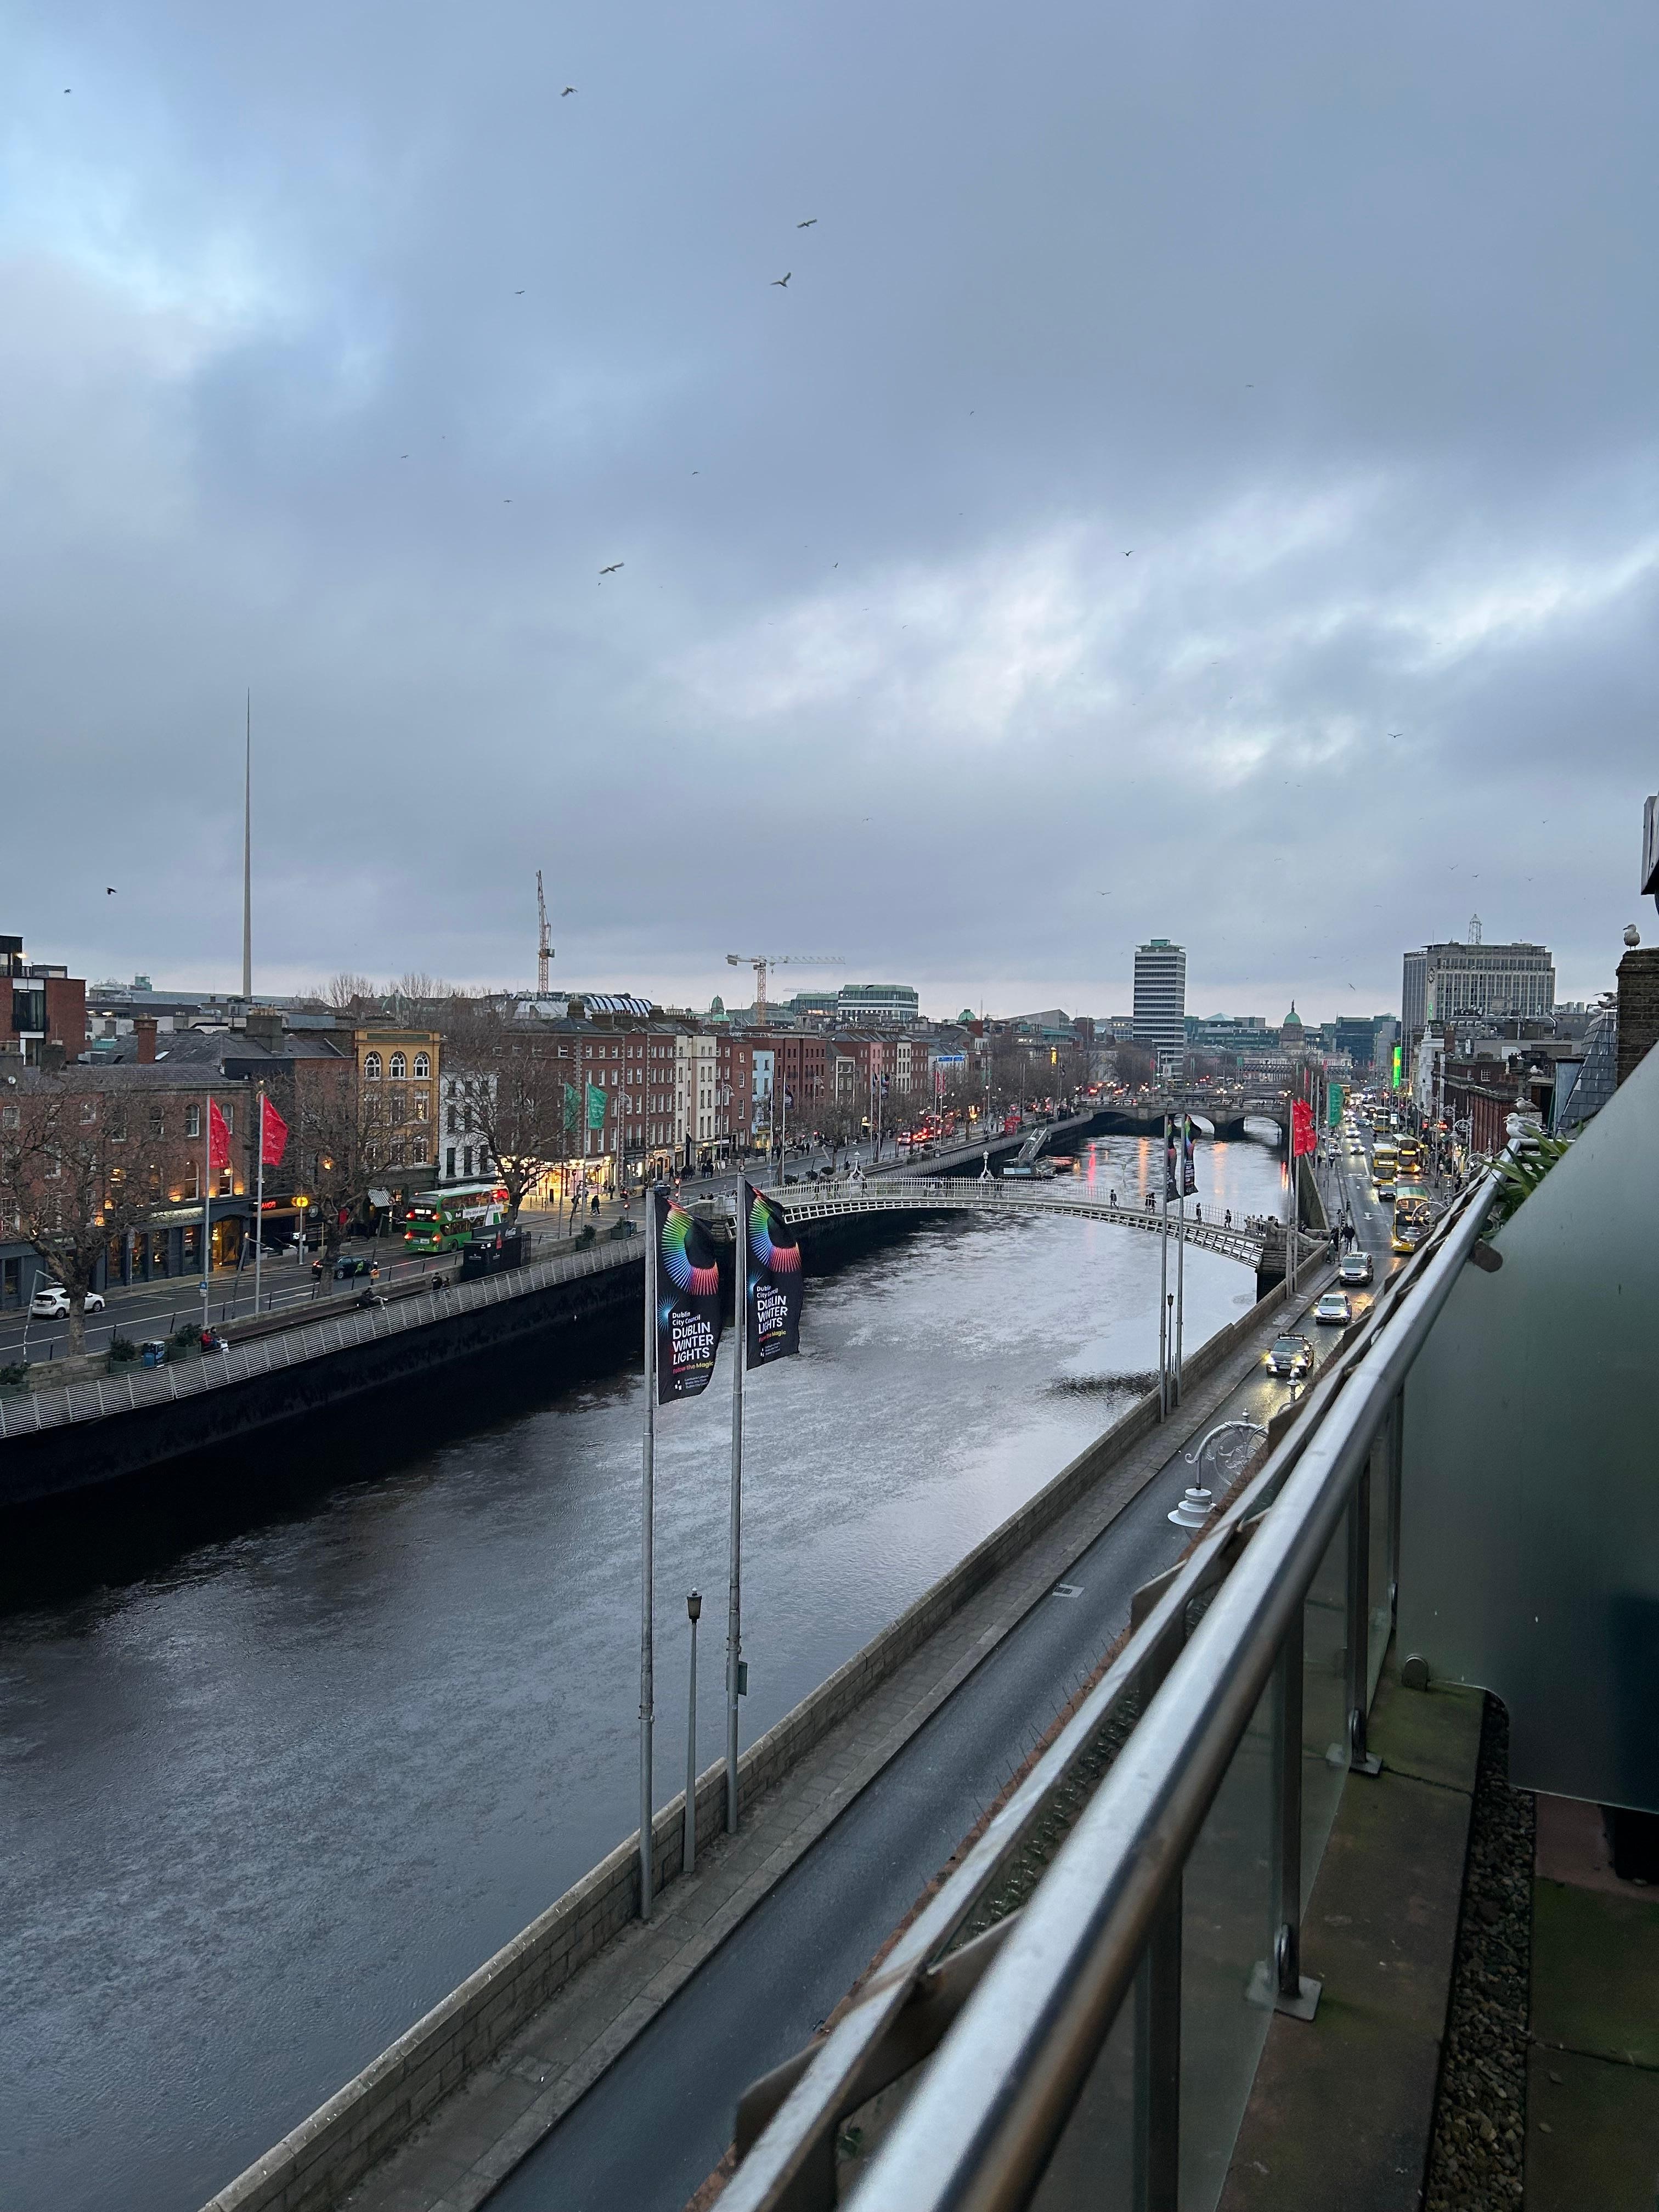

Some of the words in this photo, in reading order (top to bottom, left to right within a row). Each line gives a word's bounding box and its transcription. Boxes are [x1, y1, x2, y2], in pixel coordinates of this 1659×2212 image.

[757, 1295, 787, 1311] DUBLIN
[757, 1306, 788, 1323] WINTER
[672, 1321, 711, 1340] DUBLIN
[758, 1317, 783, 1334] LIGHTS
[672, 1334, 714, 1353] WINTER
[673, 1346, 710, 1365] LIGHTS
[696, 1361, 714, 1369] Magic
